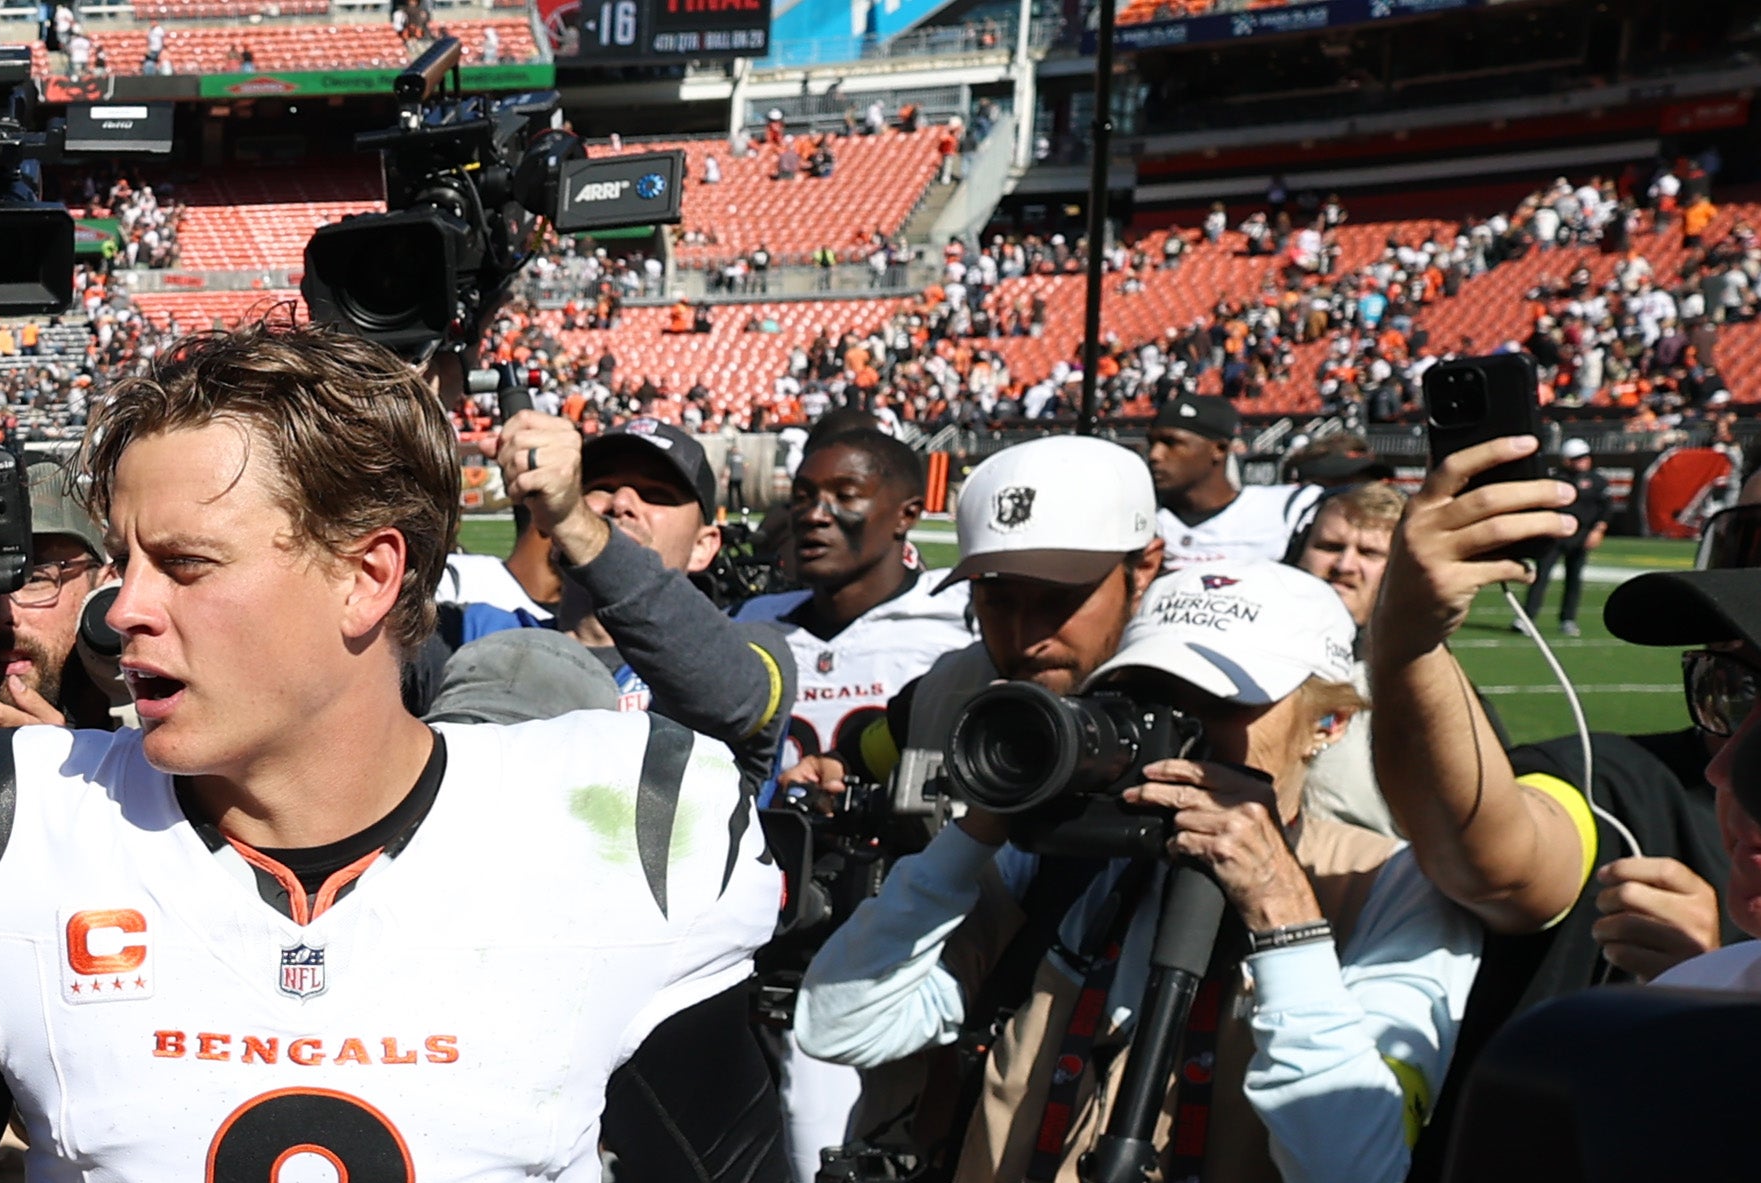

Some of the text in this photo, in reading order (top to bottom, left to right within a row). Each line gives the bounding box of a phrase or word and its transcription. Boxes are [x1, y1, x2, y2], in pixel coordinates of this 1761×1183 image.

[599, 1, 637, 45] 16
[574, 181, 621, 202] ARRI
[1151, 598, 1259, 622] AMERICAN
[1158, 611, 1232, 632] MAGIC
[795, 682, 884, 703] NGALS
[66, 908, 148, 976] C
[284, 965, 323, 992] NFL
[152, 1029, 460, 1066] BENGALS
